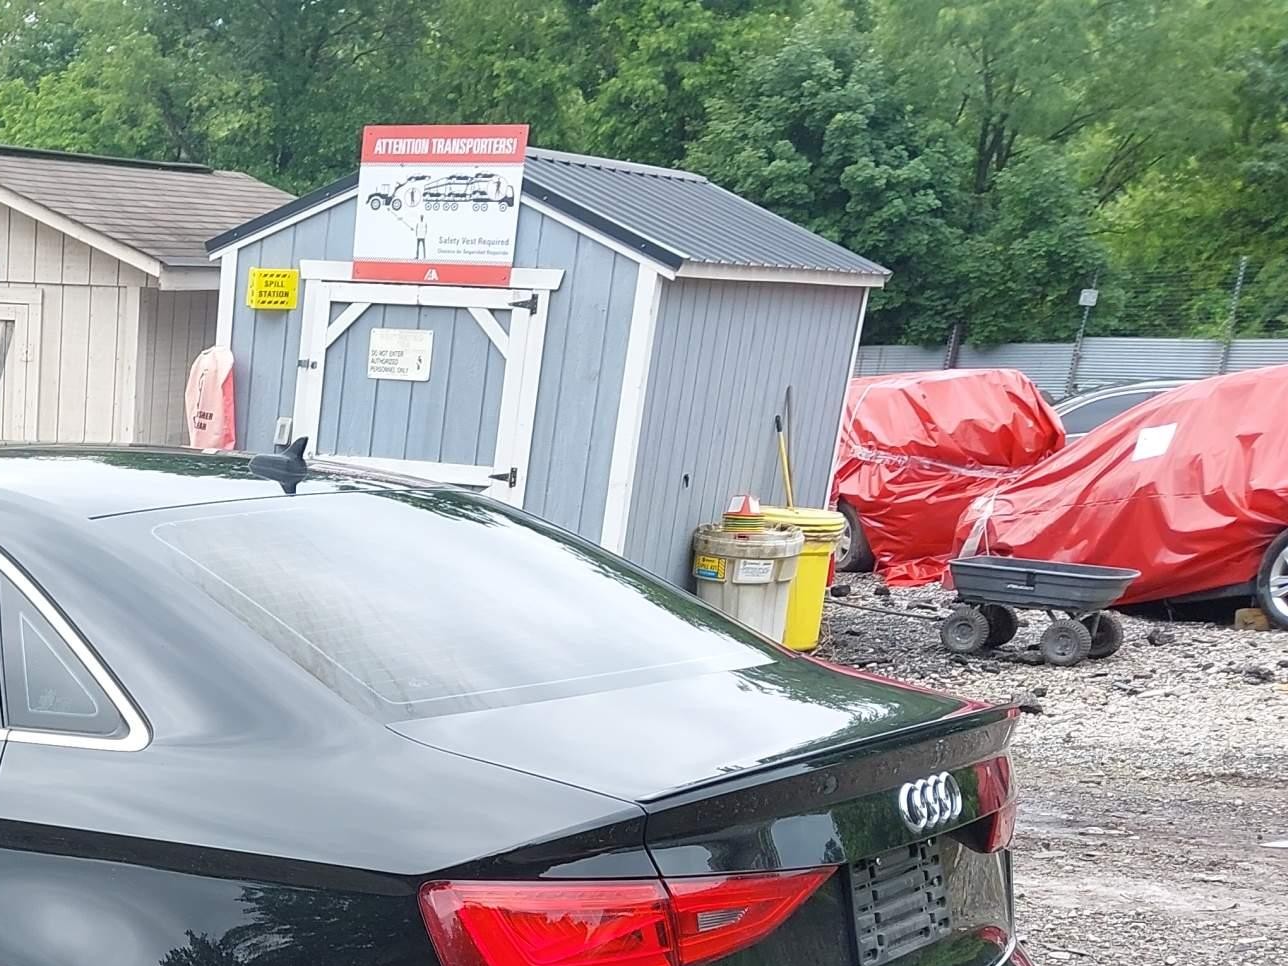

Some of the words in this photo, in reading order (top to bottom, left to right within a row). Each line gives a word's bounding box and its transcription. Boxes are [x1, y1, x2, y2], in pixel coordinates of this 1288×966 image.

[374, 138, 429, 155] ATTENTION
[431, 137, 518, 155] TRANSPORTERS!
[439, 236, 460, 246] Safety
[462, 236, 477, 245] Vest
[478, 236, 509, 246] Required
[264, 280, 284, 288] SPILL
[258, 290, 290, 298] STATION
